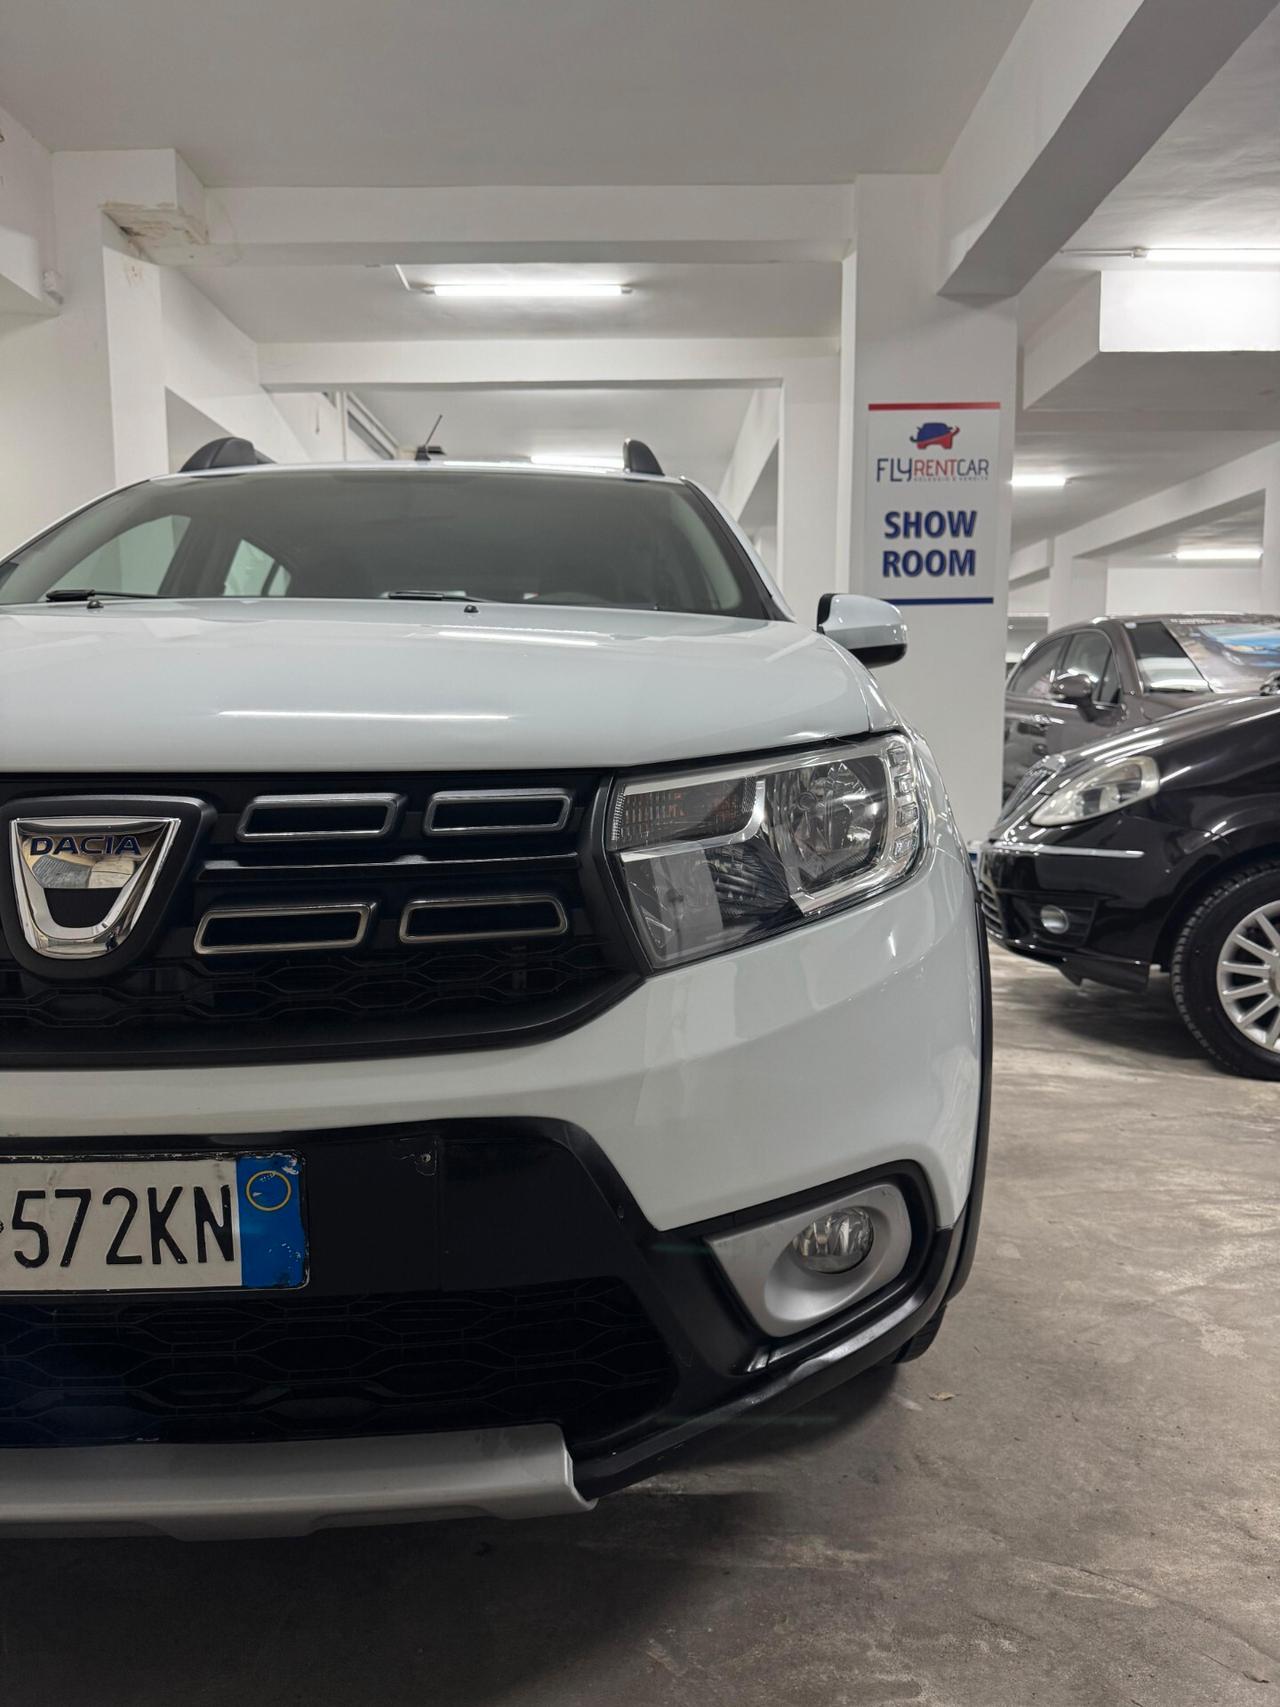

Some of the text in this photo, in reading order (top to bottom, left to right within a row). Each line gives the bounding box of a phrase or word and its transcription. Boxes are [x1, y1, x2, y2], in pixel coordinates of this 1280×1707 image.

[876, 457, 989, 482] FLYRENTCAR
[884, 510, 977, 540] SHOW
[882, 548, 976, 578] ROOM
[29, 835, 143, 856] DACIA
[11, 1184, 235, 1269] 572KN
